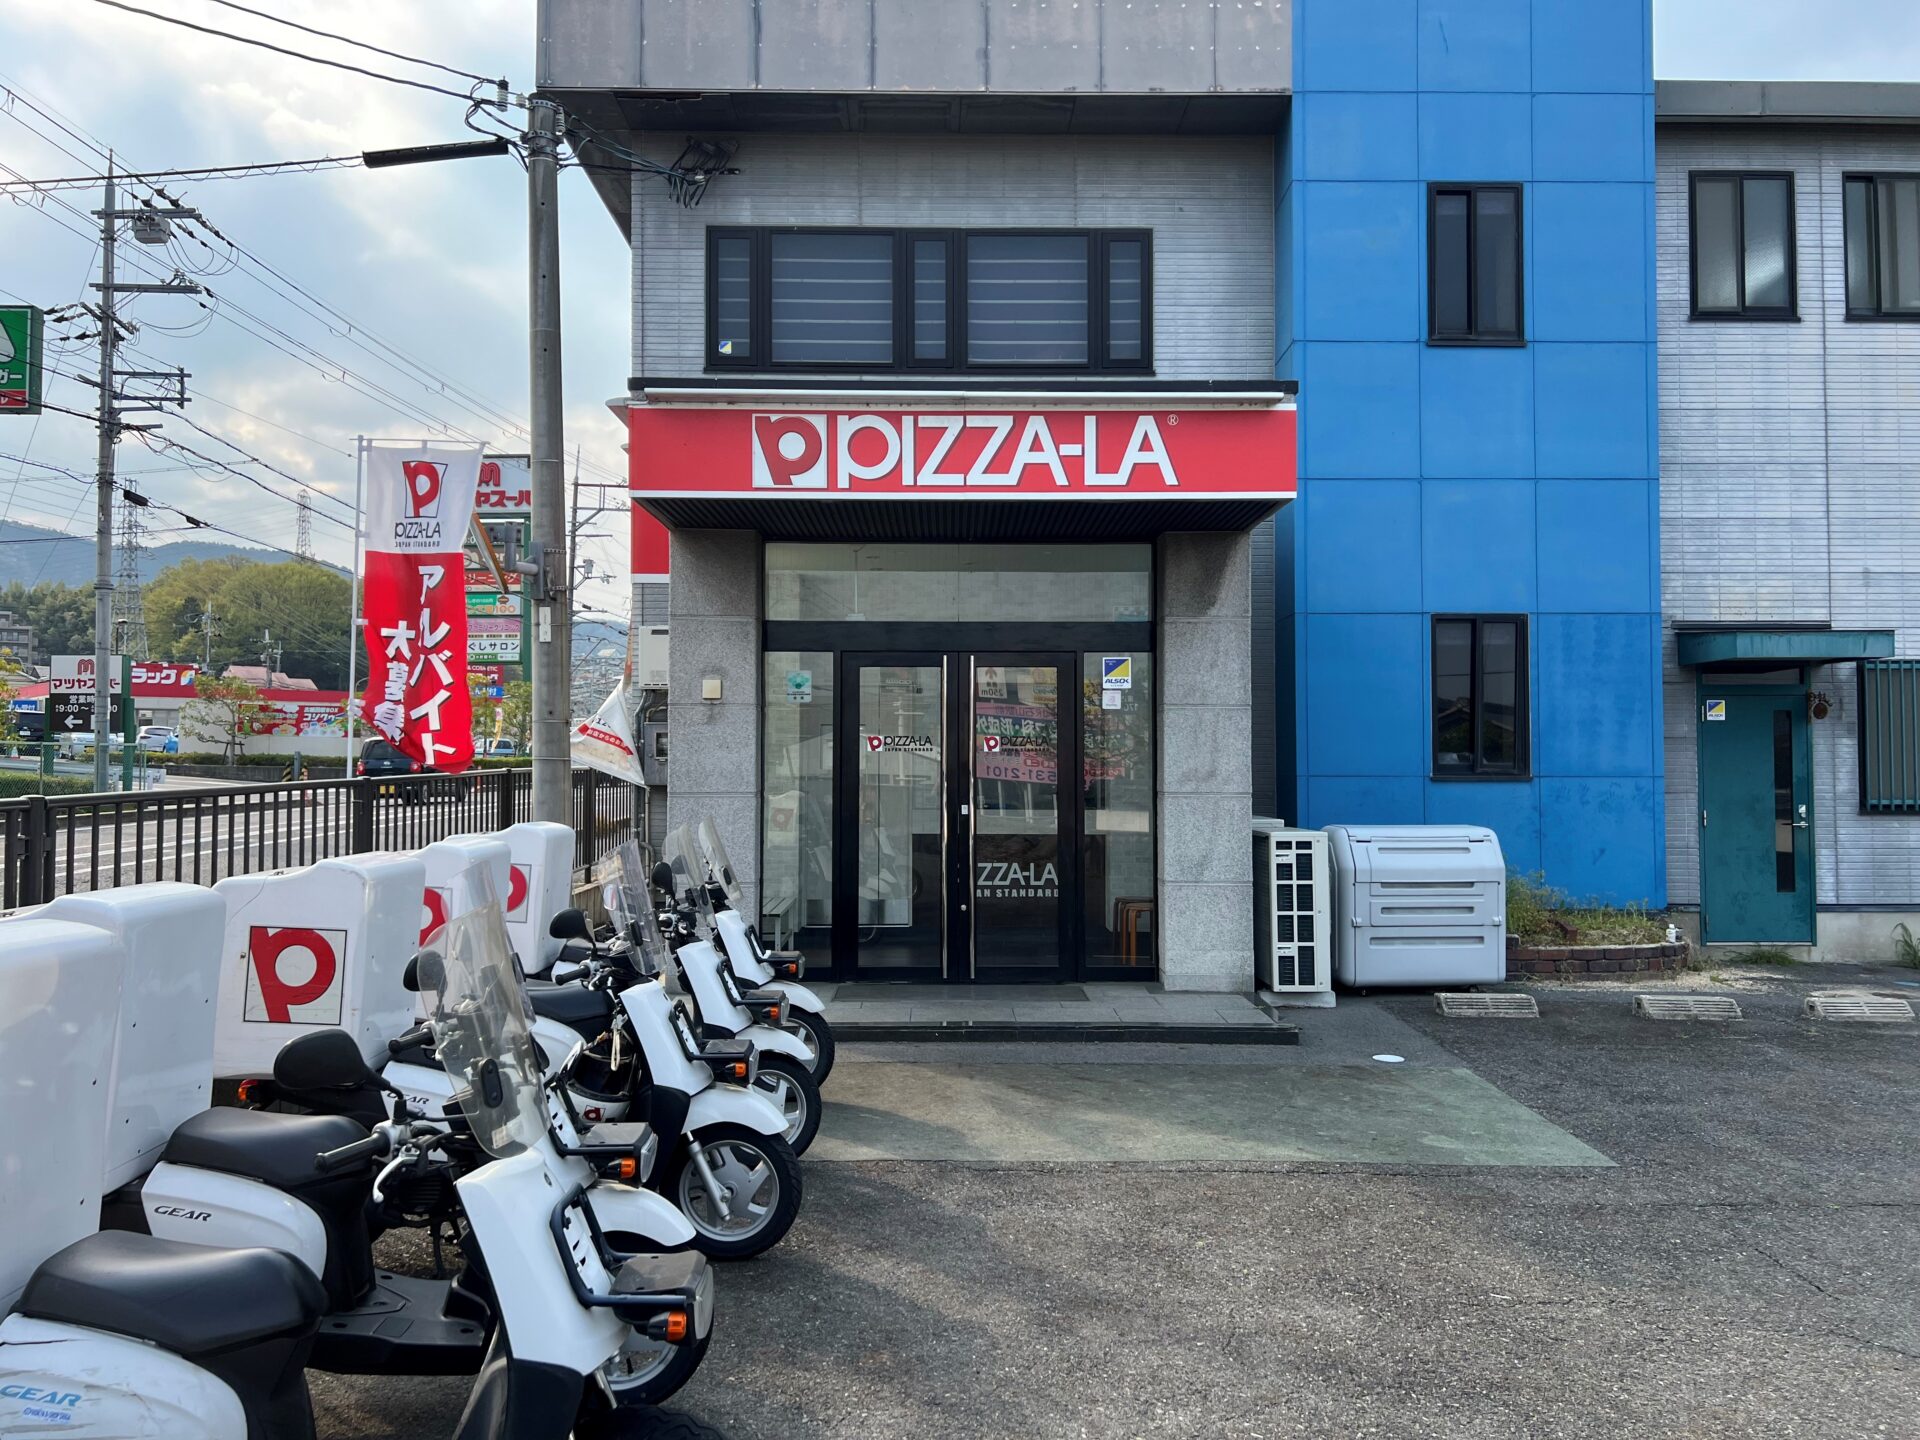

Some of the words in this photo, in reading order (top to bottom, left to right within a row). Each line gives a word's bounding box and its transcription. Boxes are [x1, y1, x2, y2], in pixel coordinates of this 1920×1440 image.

[408, 565, 458, 767] アルバイト
[373, 620, 417, 746] 大募集
[996, 888, 1059, 898] STANDARD
[154, 1205, 212, 1222] GEAR
[0, 1384, 83, 1407] GEAR
